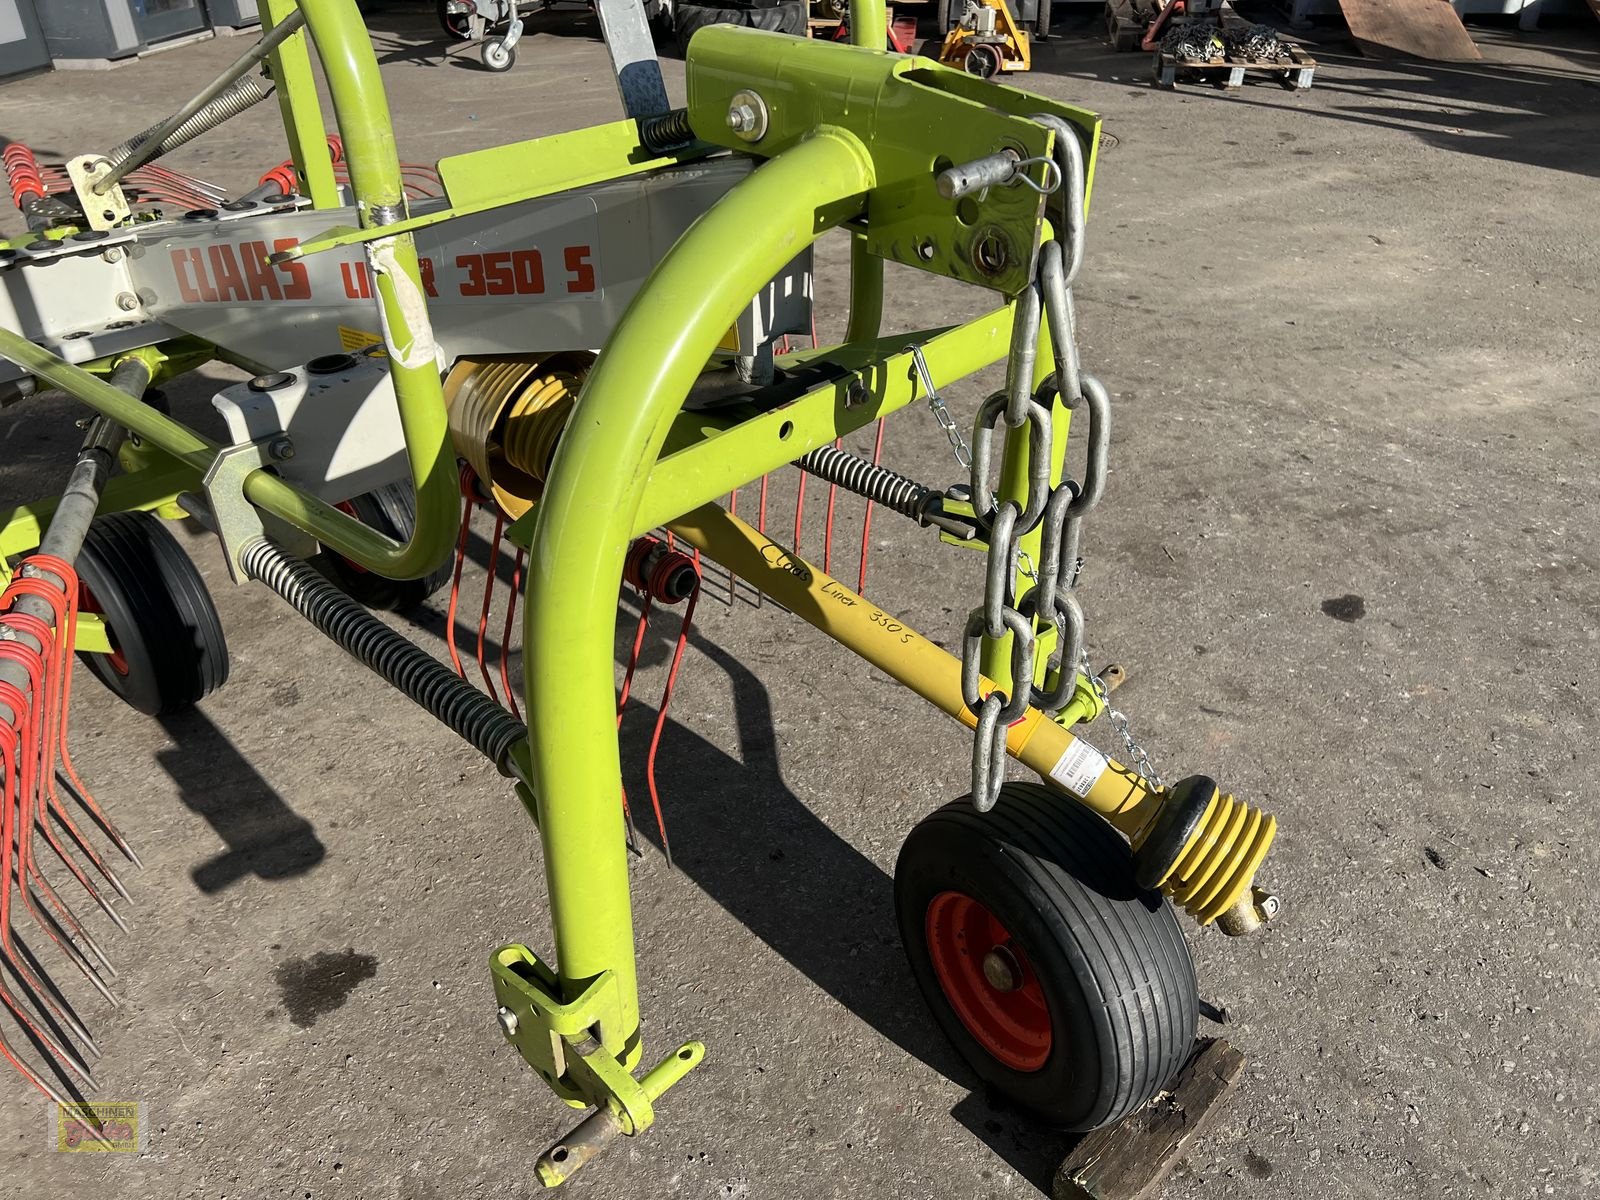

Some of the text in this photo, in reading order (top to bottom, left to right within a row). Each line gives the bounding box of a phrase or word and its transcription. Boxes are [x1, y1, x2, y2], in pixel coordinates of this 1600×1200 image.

[170, 237, 312, 303] CLAAS
[455, 249, 545, 297] 350
[563, 245, 596, 294] S
[760, 543, 810, 582] Claas
[820, 581, 858, 607] Liner
[869, 610, 903, 633] 350
